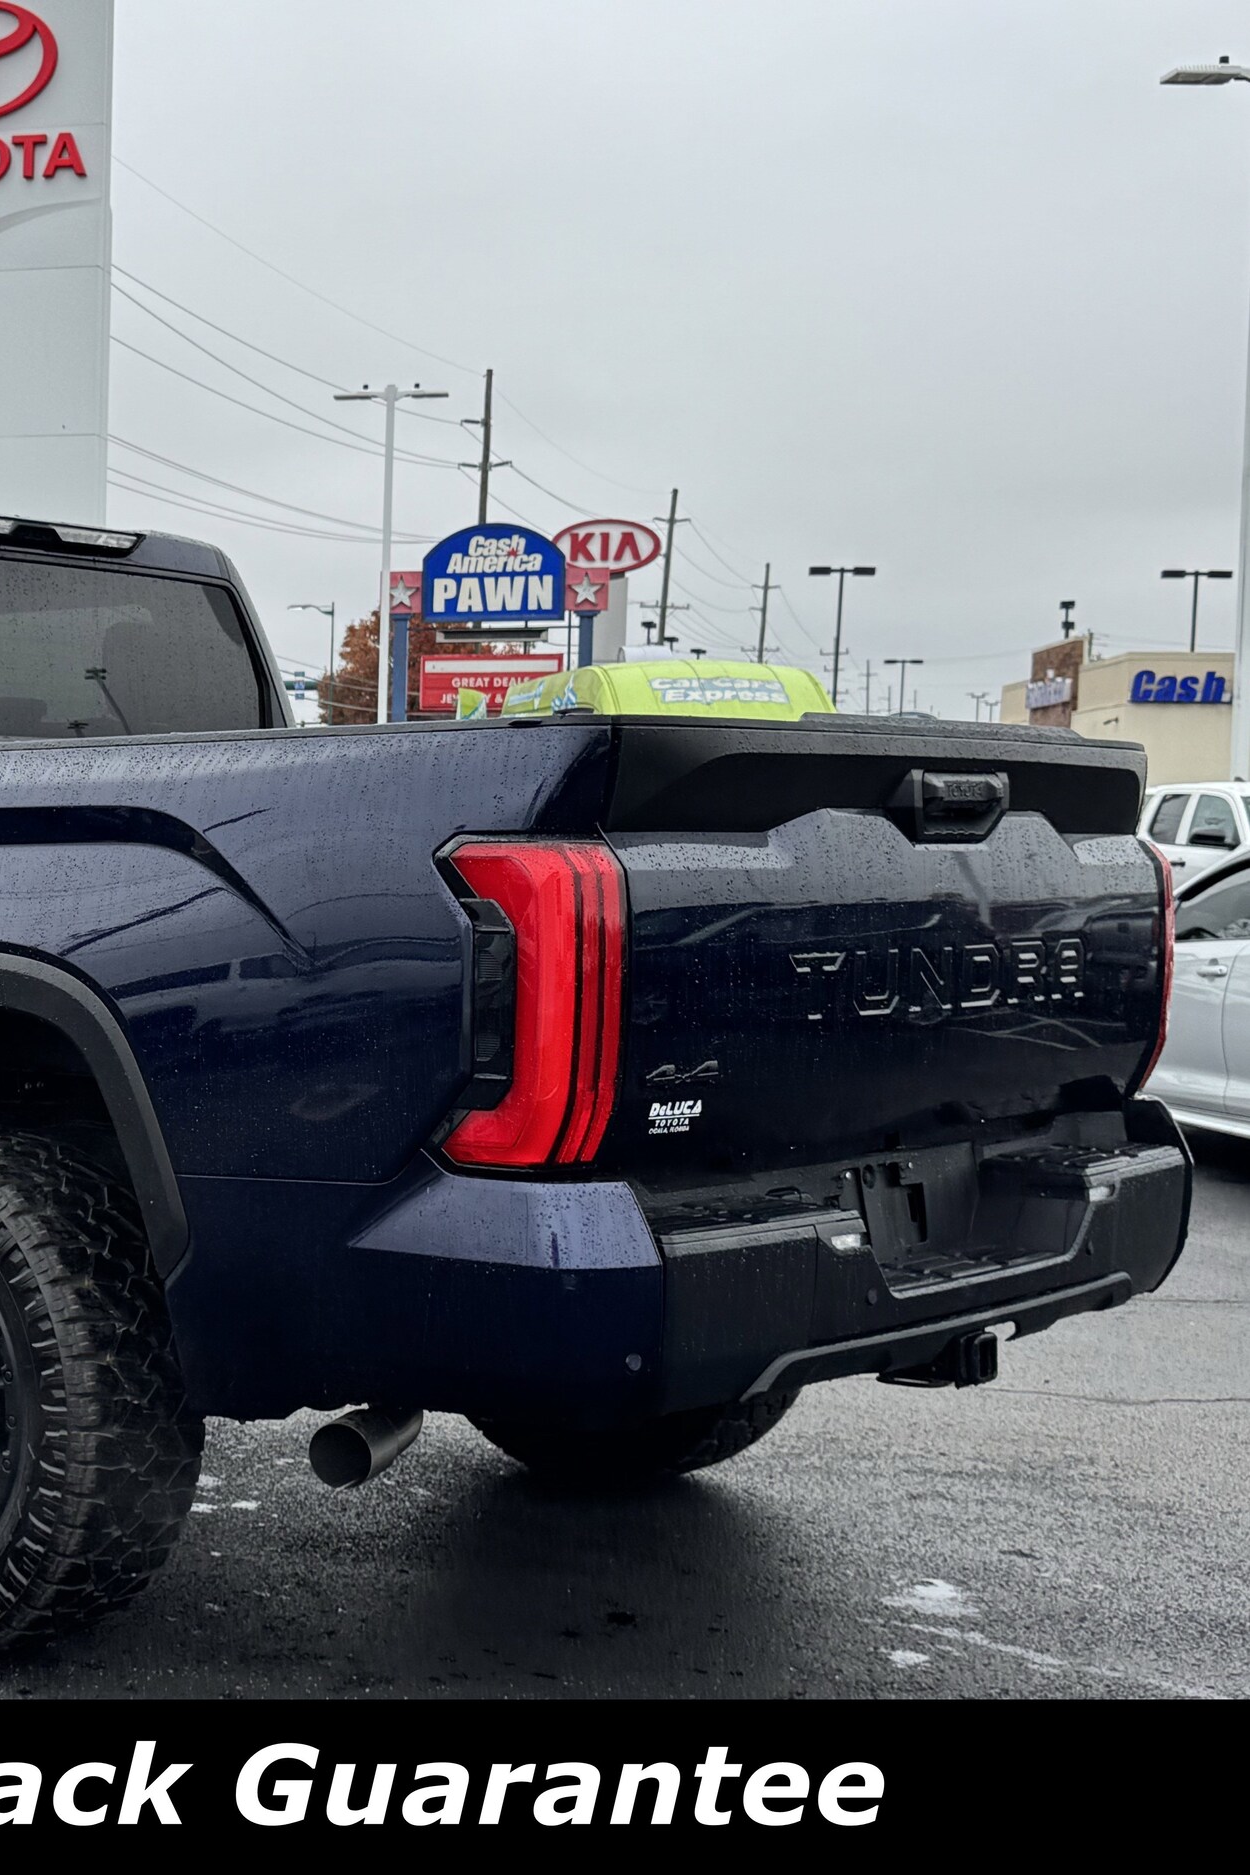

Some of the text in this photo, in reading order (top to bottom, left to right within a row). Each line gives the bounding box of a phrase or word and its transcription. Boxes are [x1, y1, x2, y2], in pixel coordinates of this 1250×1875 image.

[468, 534, 526, 557] Cash
[569, 531, 642, 562] KIA
[446, 552, 543, 574] America
[432, 574, 554, 613] PAWN
[452, 677, 490, 688] GREAT
[651, 678, 704, 690] Car
[1130, 670, 1226, 704] Cash
[664, 689, 790, 705] Express
[789, 938, 1086, 1020] TUNDRA
[655, 1118, 690, 1127] TOYOTA
